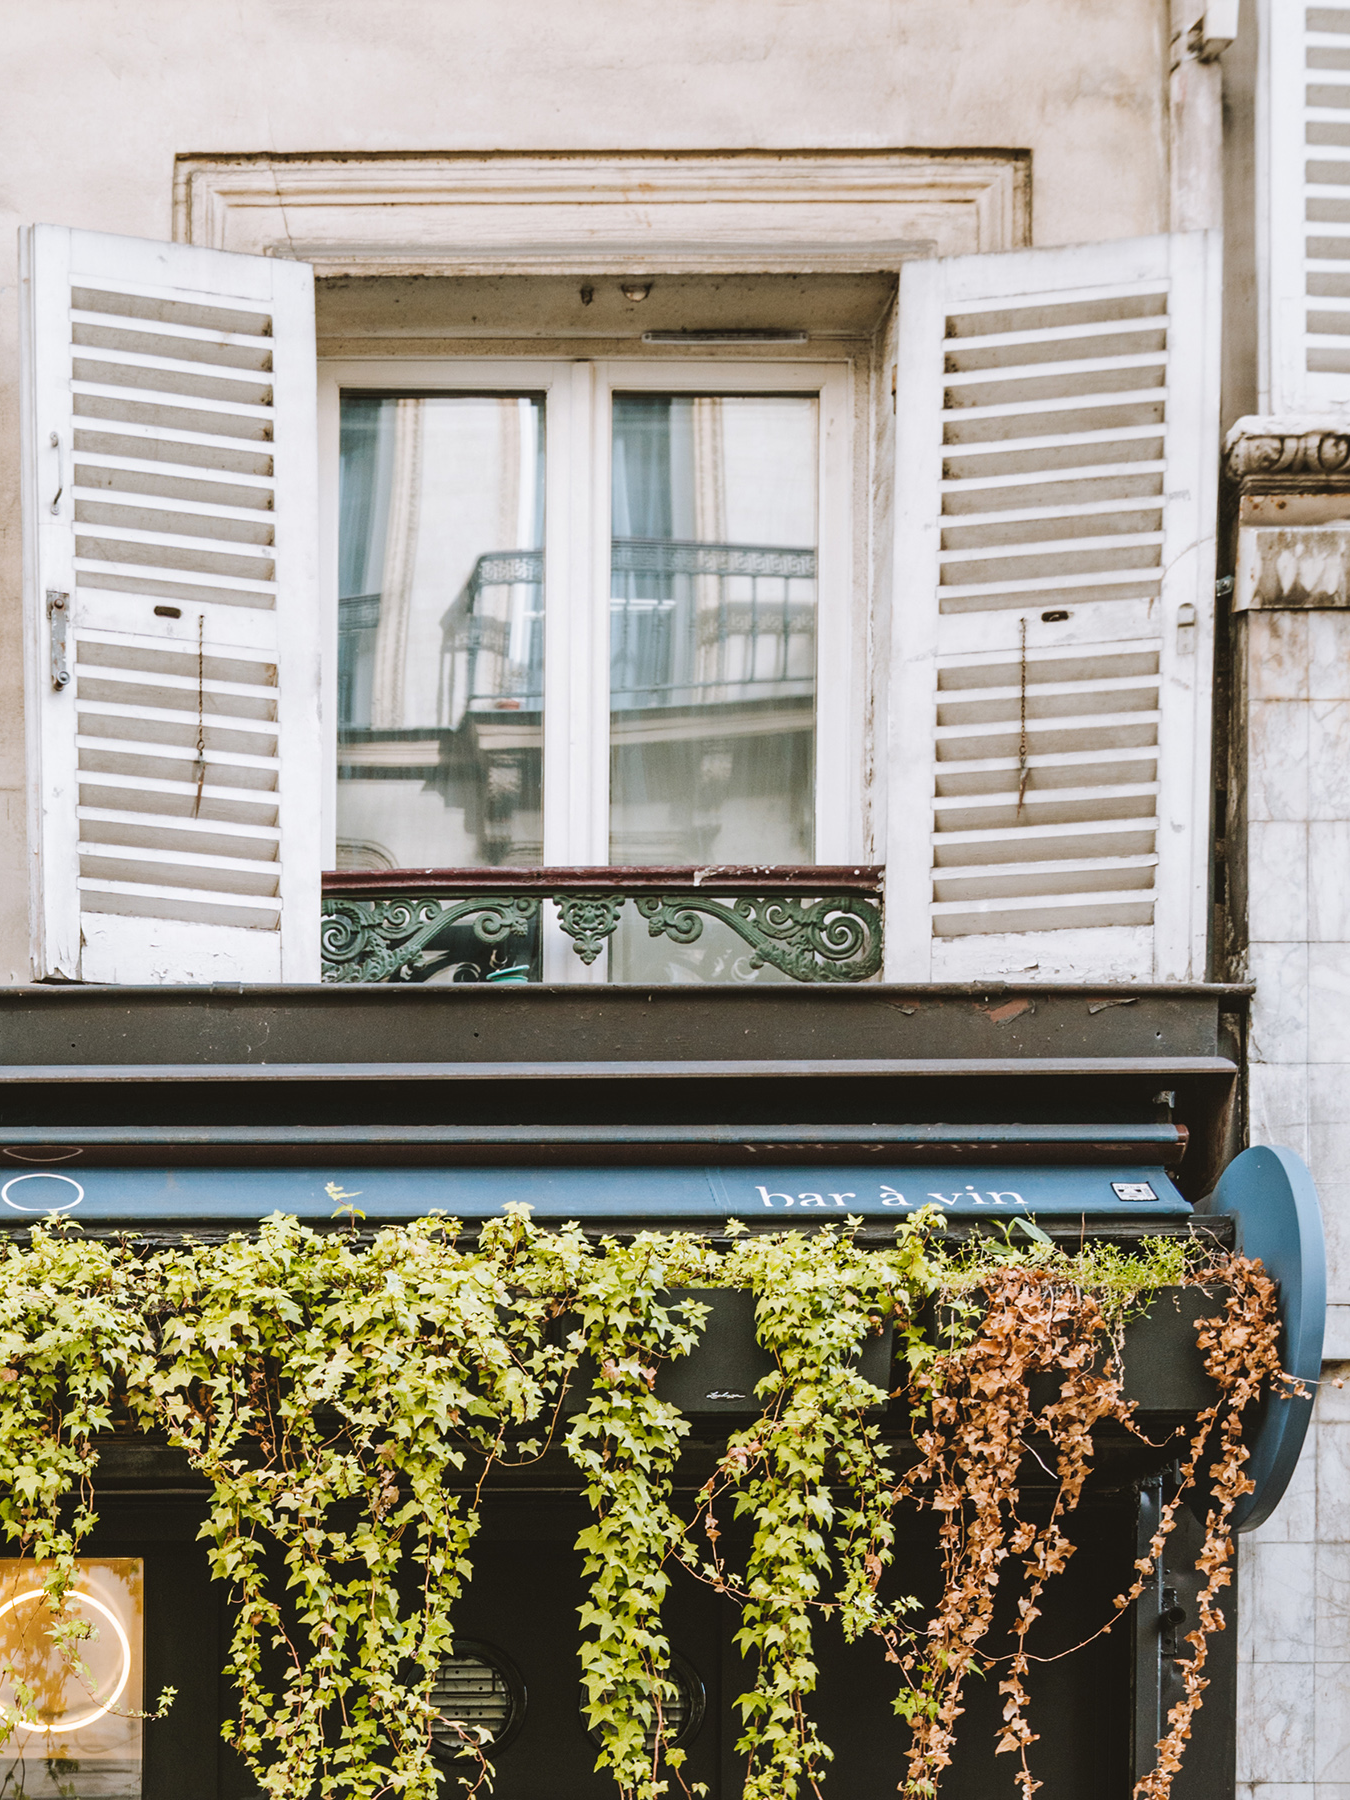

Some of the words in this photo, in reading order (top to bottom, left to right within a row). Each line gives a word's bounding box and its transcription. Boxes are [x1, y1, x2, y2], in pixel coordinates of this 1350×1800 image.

[755, 1185, 857, 1208] bar
[879, 1184, 914, 1207] à
[927, 1184, 1030, 1207] vin
